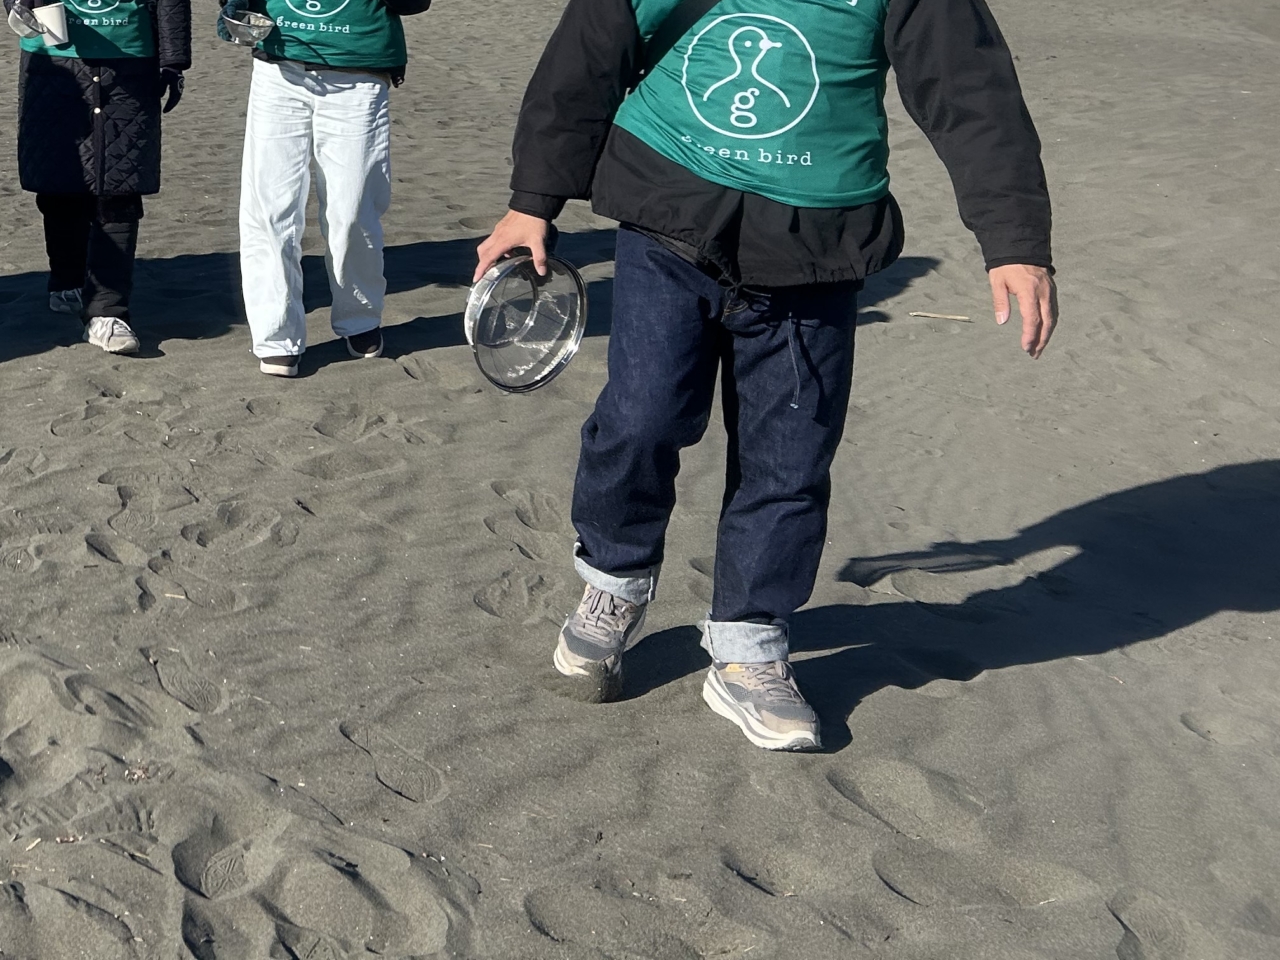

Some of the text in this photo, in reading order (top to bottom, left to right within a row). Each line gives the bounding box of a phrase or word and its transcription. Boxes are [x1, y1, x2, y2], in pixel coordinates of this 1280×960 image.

[68, 17, 129, 26] reen bird
[276, 16, 350, 34] green bird
[729, 87, 760, 128] g
[758, 148, 813, 166] bird
